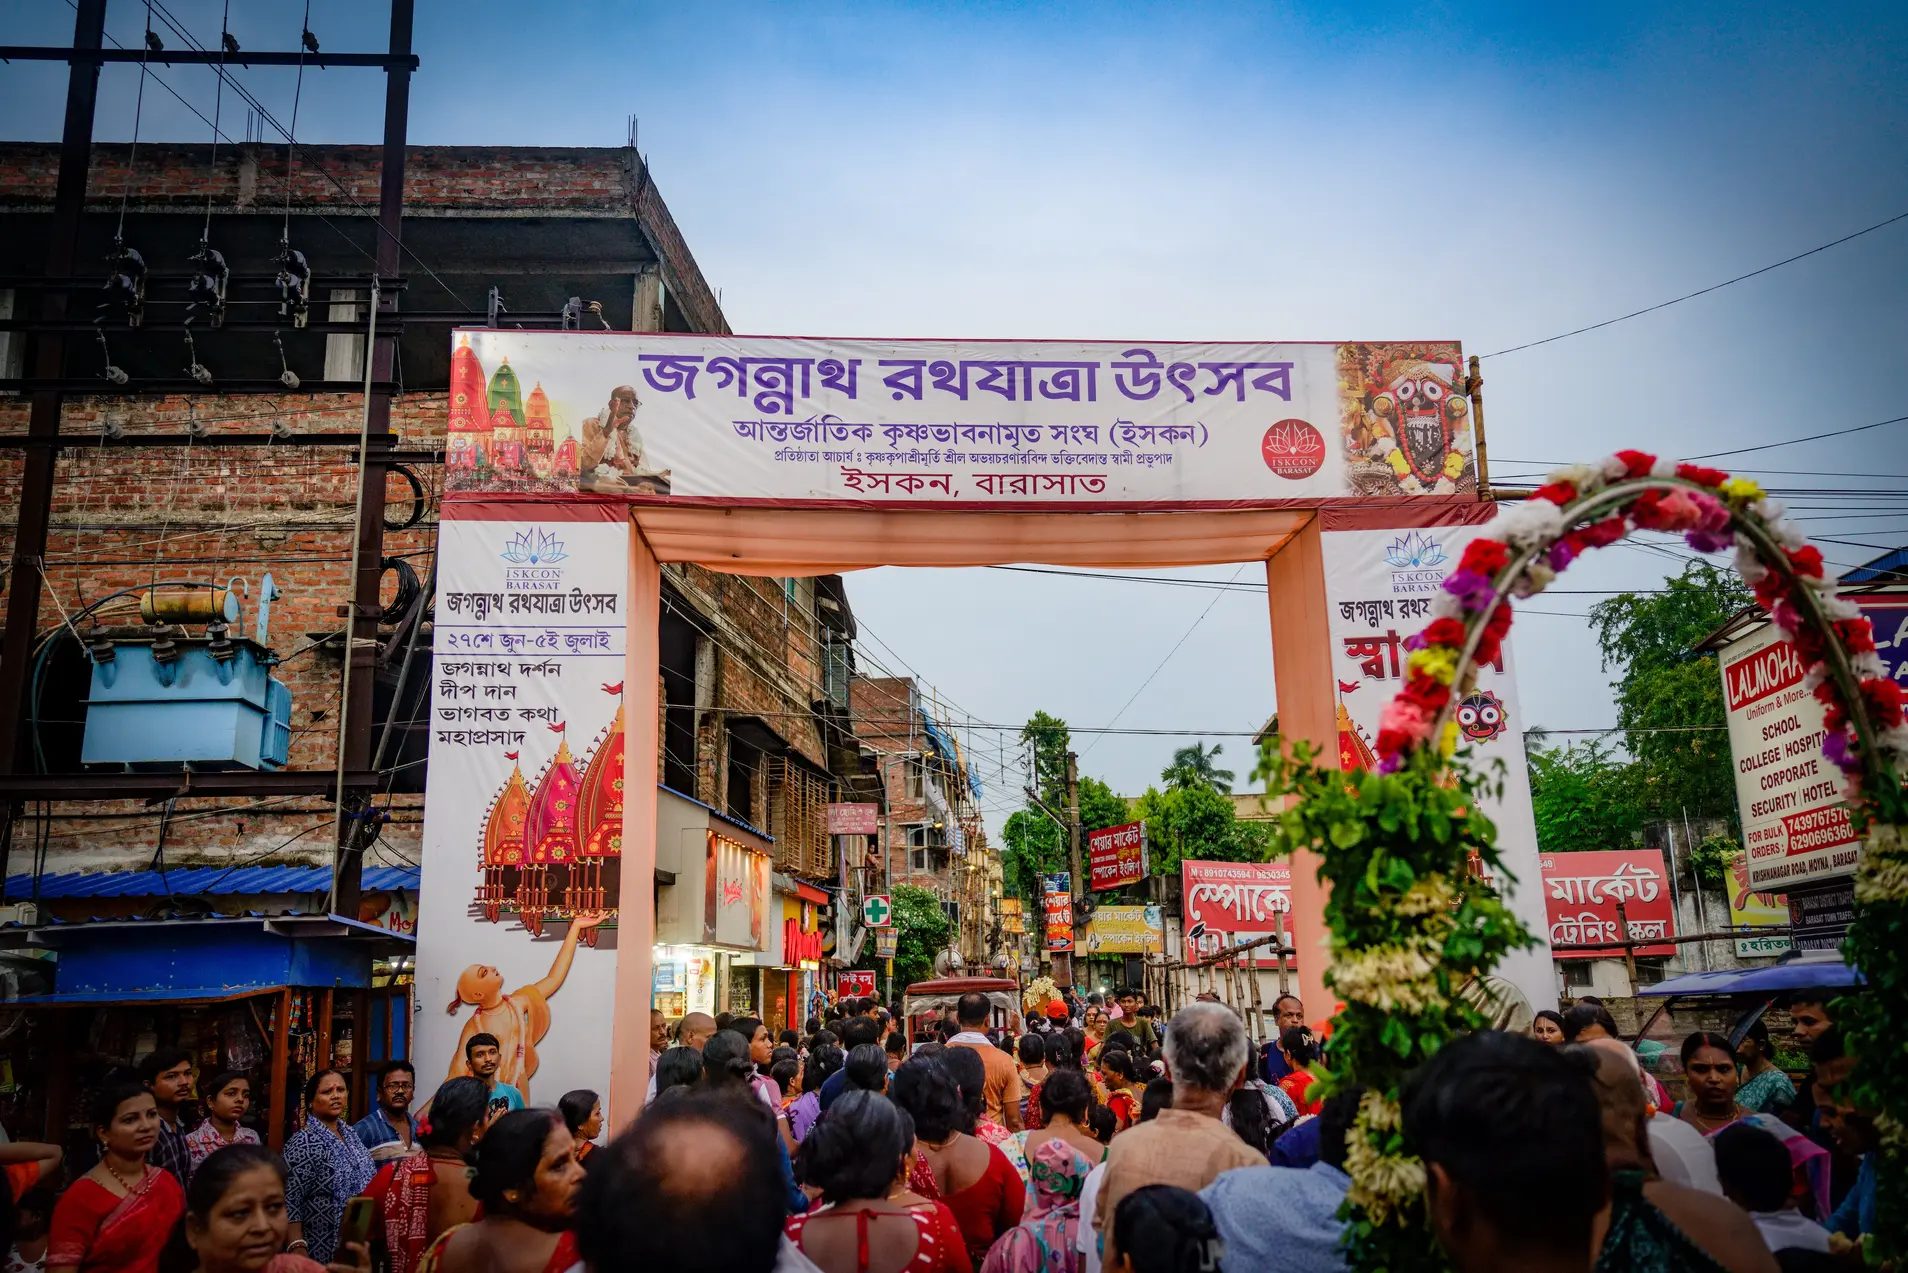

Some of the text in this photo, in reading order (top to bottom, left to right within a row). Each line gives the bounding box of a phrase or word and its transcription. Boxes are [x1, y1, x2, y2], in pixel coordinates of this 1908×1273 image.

[638, 349, 1294, 415] জগন্নাথ রথযাত্রা উৎসব
[732, 414, 1209, 450] আন্তর্জাতিক কৃষ্ণভাবনামৃত সংঘ (ইসকন)
[774, 446, 819, 463] প্রতিষ্ঠাতা
[823, 448, 855, 463] আচার্য
[1109, 449, 1133, 465] স্বামী
[1136, 452, 1172, 468] প্রভুপাদ
[1272, 458, 1316, 467] ISKCON
[840, 465, 1108, 498] ইসকন, বারাসাত
[1277, 467, 1312, 475] BARASAT
[506, 569, 561, 579] ISKCON
[506, 581, 561, 590] BARASAT
[1391, 572, 1444, 582] ISKCON
[447, 587, 618, 621] জগন্নাথ রথযাত্রা উৎসব
[1338, 599, 1394, 628] জগন্নাথ
[447, 632, 494, 649] ২৭শে
[563, 629, 612, 654] জুলাই
[441, 658, 562, 678] জগন্নাথ দর্শন
[439, 679, 517, 700] দীপ দান
[437, 706, 559, 723] ভাগবত কথা
[1746, 701, 1775, 721] Uniform
[1775, 696, 1783, 709] &
[436, 729, 526, 746] মহাপ্রসাদ
[1762, 714, 1801, 742] SCHOOL
[1740, 747, 1781, 774] COLLEGE
[1760, 759, 1819, 791] CORPORATE
[1751, 780, 1838, 818] SECURITY HOTEL
[1787, 807, 1852, 834] 7439767576
[1113, 825, 1139, 847] মার্কেট
[1748, 825, 1784, 844] FOR BULK
[1790, 822, 1855, 851] 6290696360
[1751, 842, 1780, 859] ORDERS
[1545, 862, 1660, 905] মার্কেট
[1549, 911, 1619, 945] ট্রেনিং
